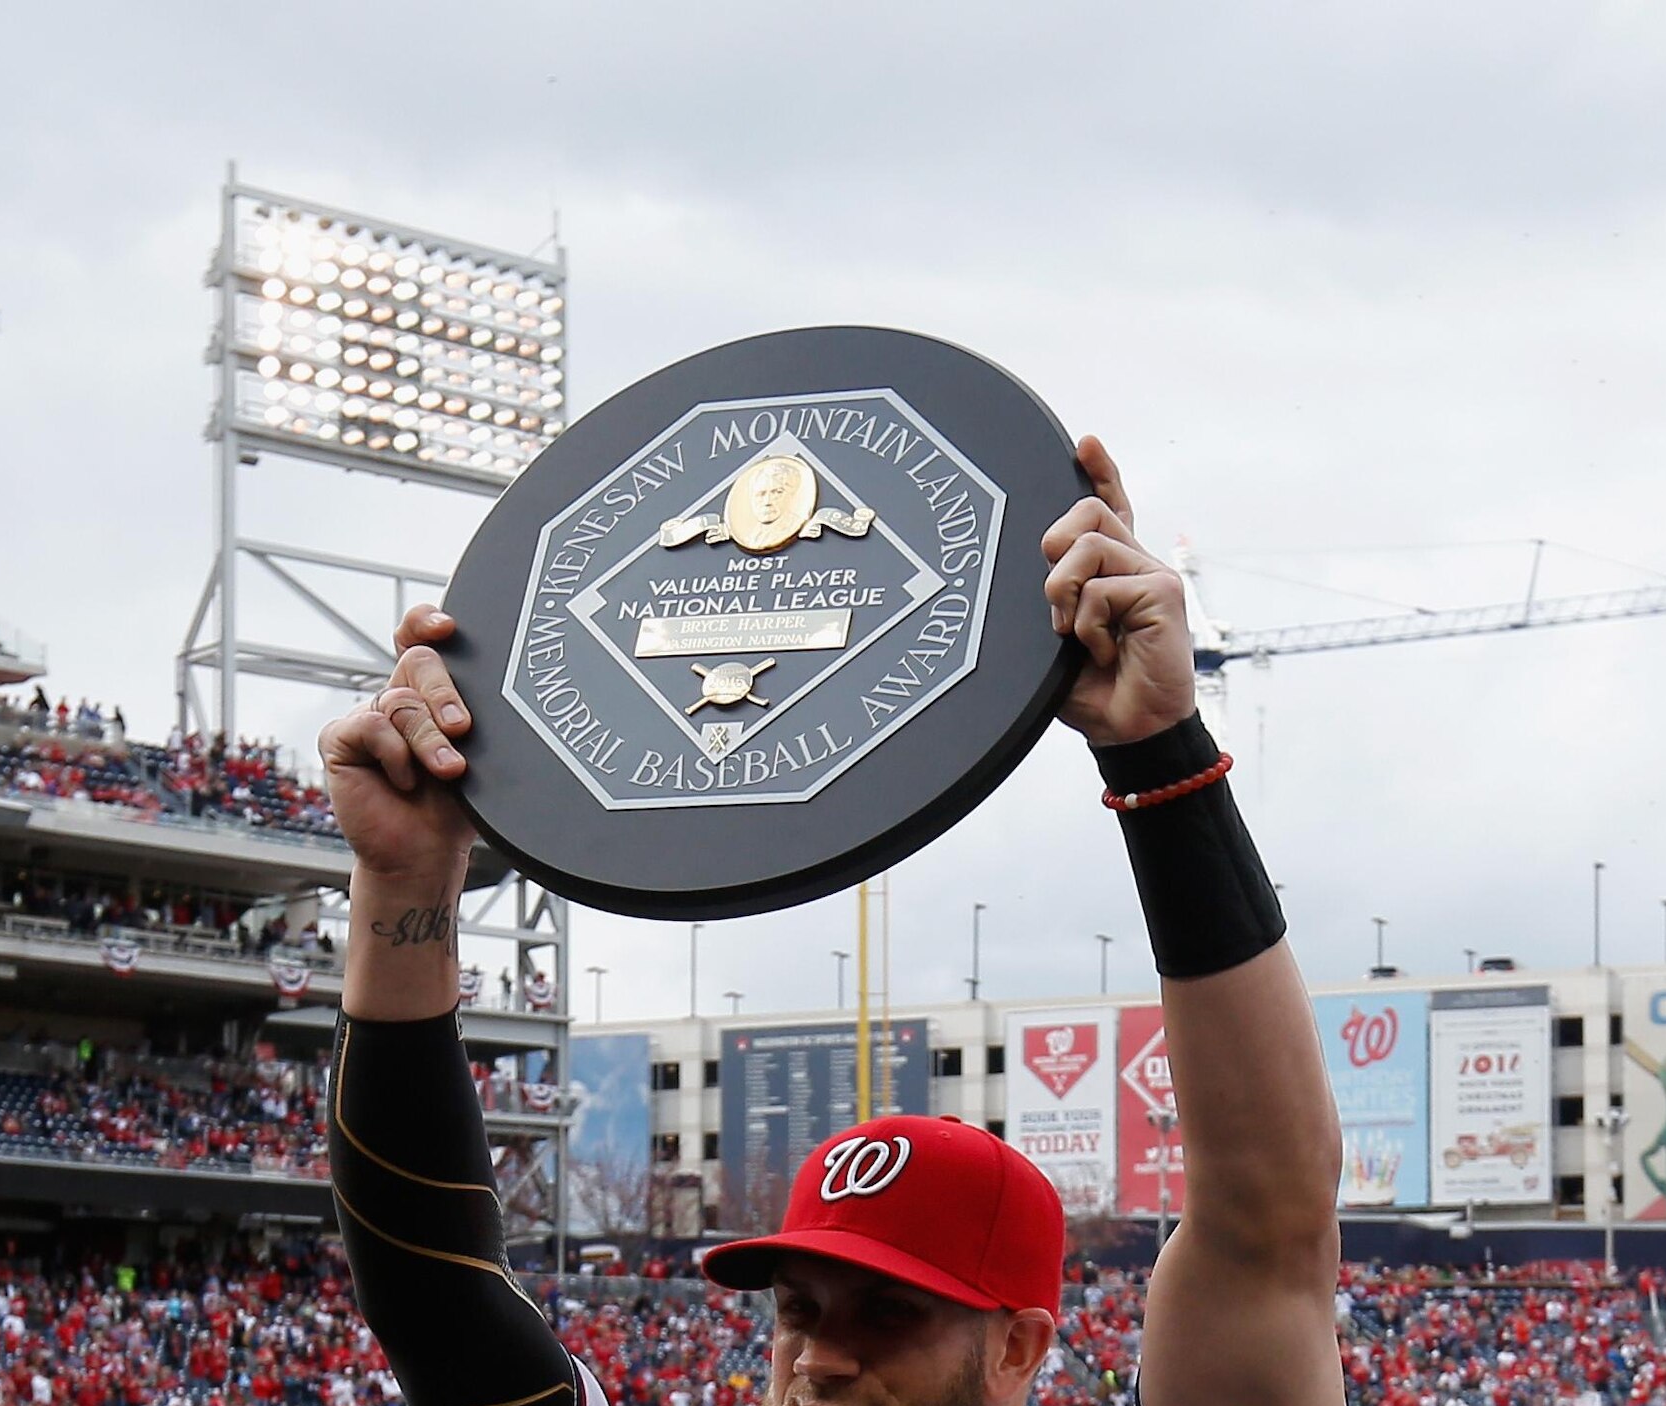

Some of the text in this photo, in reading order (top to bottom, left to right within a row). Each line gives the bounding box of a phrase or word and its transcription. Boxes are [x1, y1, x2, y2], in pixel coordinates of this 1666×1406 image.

[538, 408, 982, 595] KENESAW MOUNTAIN LANDIS
[726, 555, 789, 572] MOST
[648, 569, 858, 596] VALUABLE PLAYER
[618, 588, 886, 620] NATIONAL LEAGUE
[680, 615, 807, 633] BRYCE HARPER
[527, 593, 970, 791] MEMORIAL BASEBALL AWARD
[1020, 1132, 1101, 1155] TODAY
